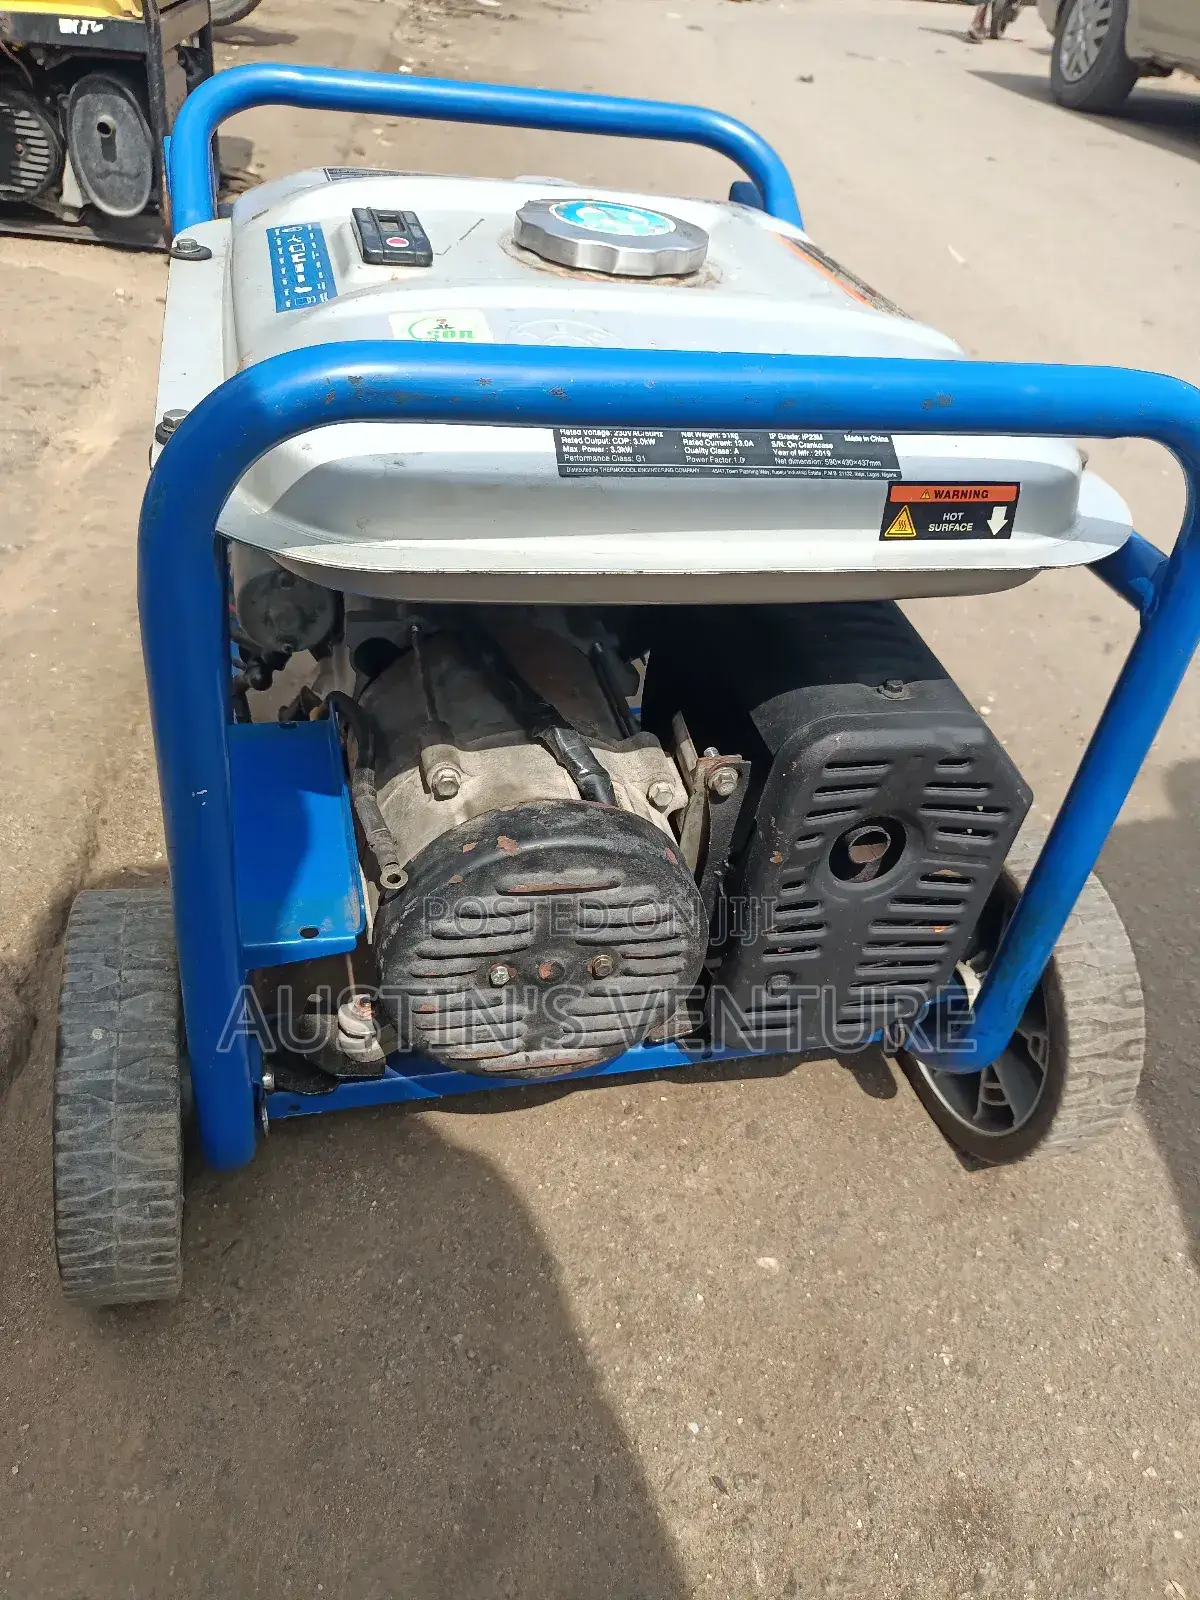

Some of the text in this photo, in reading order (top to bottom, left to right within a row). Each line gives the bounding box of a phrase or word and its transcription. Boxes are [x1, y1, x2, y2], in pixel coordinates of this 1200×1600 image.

[561, 436, 656, 446] Rated Output: COP: 3.0kW
[705, 439, 733, 447] Current:
[734, 440, 754, 448] 13.0A
[844, 435, 862, 443] Made
[870, 435, 889, 443] China
[563, 445, 580, 453] Max.
[610, 445, 633, 453] 3.3kW
[684, 447, 709, 456] Quality
[710, 447, 732, 455] Class:
[815, 449, 831, 457] 2019
[564, 454, 610, 462] Performance
[611, 454, 634, 462] Class:
[775, 457, 788, 465] Net
[788, 457, 824, 466] dimension:
[934, 490, 989, 499] WARNING
[943, 512, 964, 521] HOT
[928, 522, 973, 532] SURFACE
